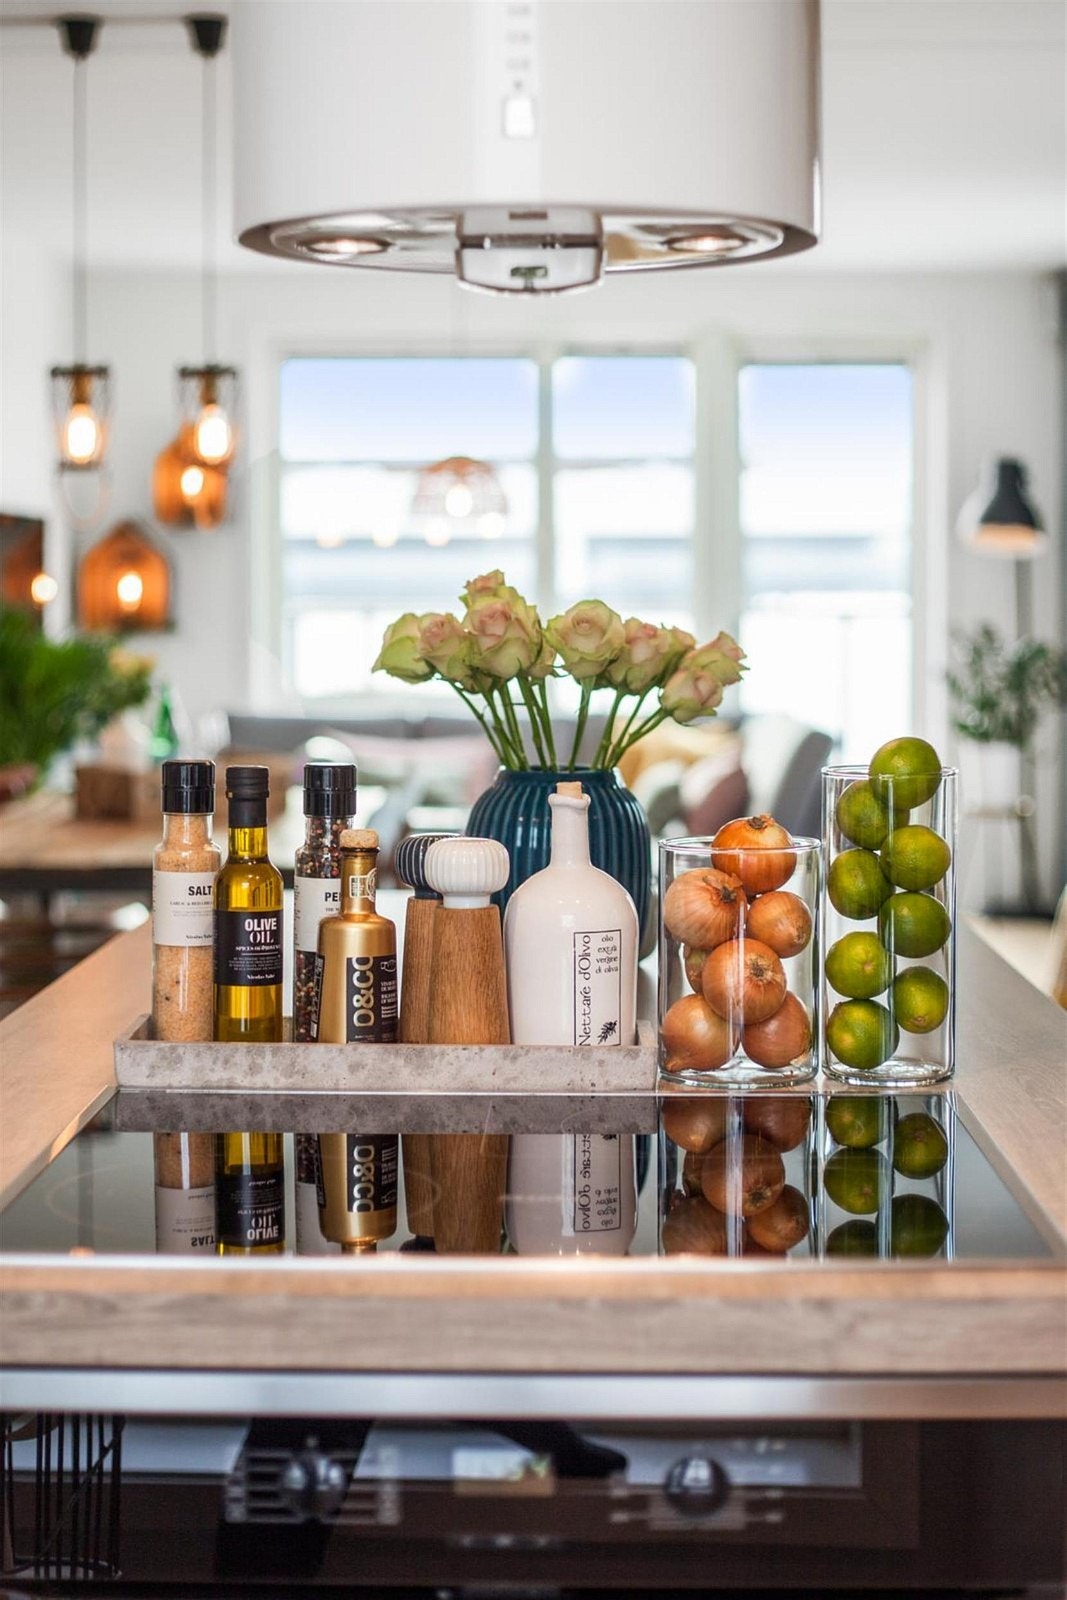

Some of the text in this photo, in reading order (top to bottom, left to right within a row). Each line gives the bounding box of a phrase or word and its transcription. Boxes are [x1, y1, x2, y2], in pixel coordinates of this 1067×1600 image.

[188, 885, 212, 896] SALT
[324, 891, 341, 902] PE
[245, 918, 277, 931] OLIVE
[249, 931, 274, 943] OIL
